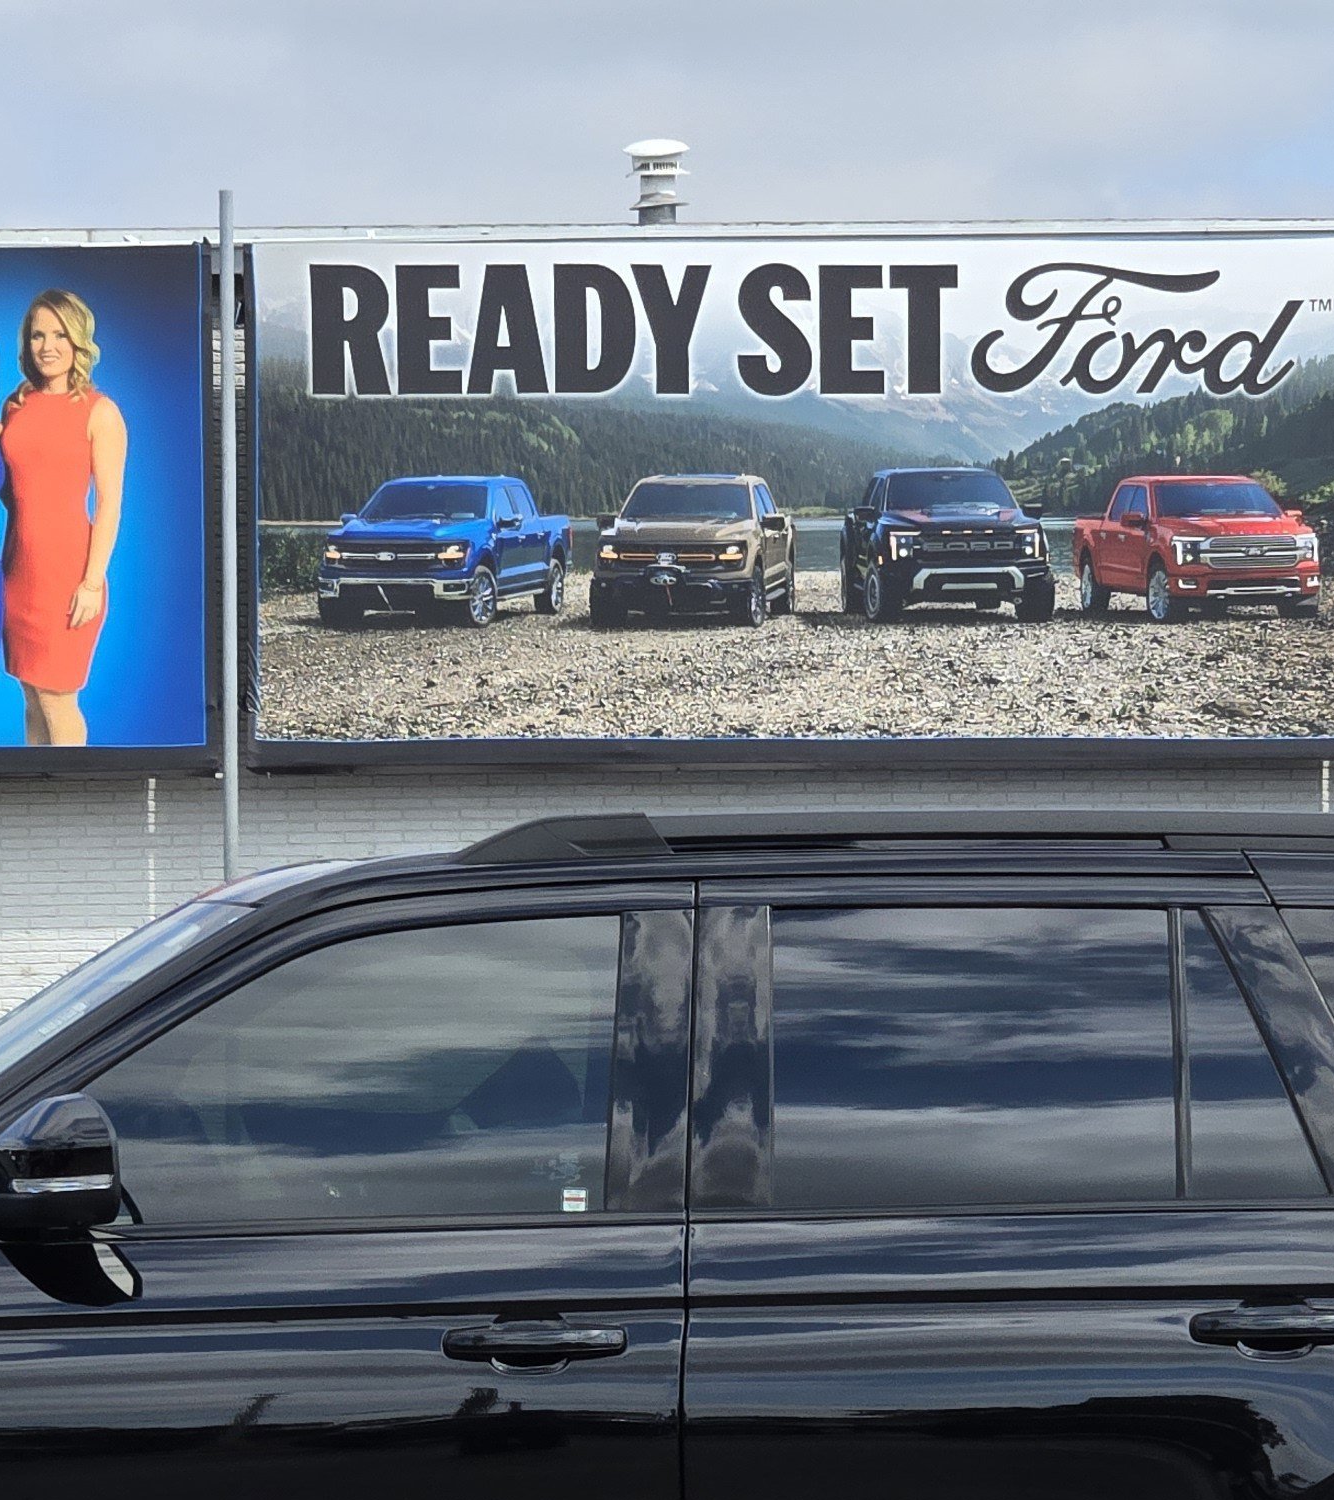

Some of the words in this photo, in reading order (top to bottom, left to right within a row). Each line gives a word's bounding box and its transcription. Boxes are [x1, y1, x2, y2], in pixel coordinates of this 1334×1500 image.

[308, 262, 712, 396] READY
[736, 261, 958, 397] SET
[970, 261, 1305, 396] Ford
